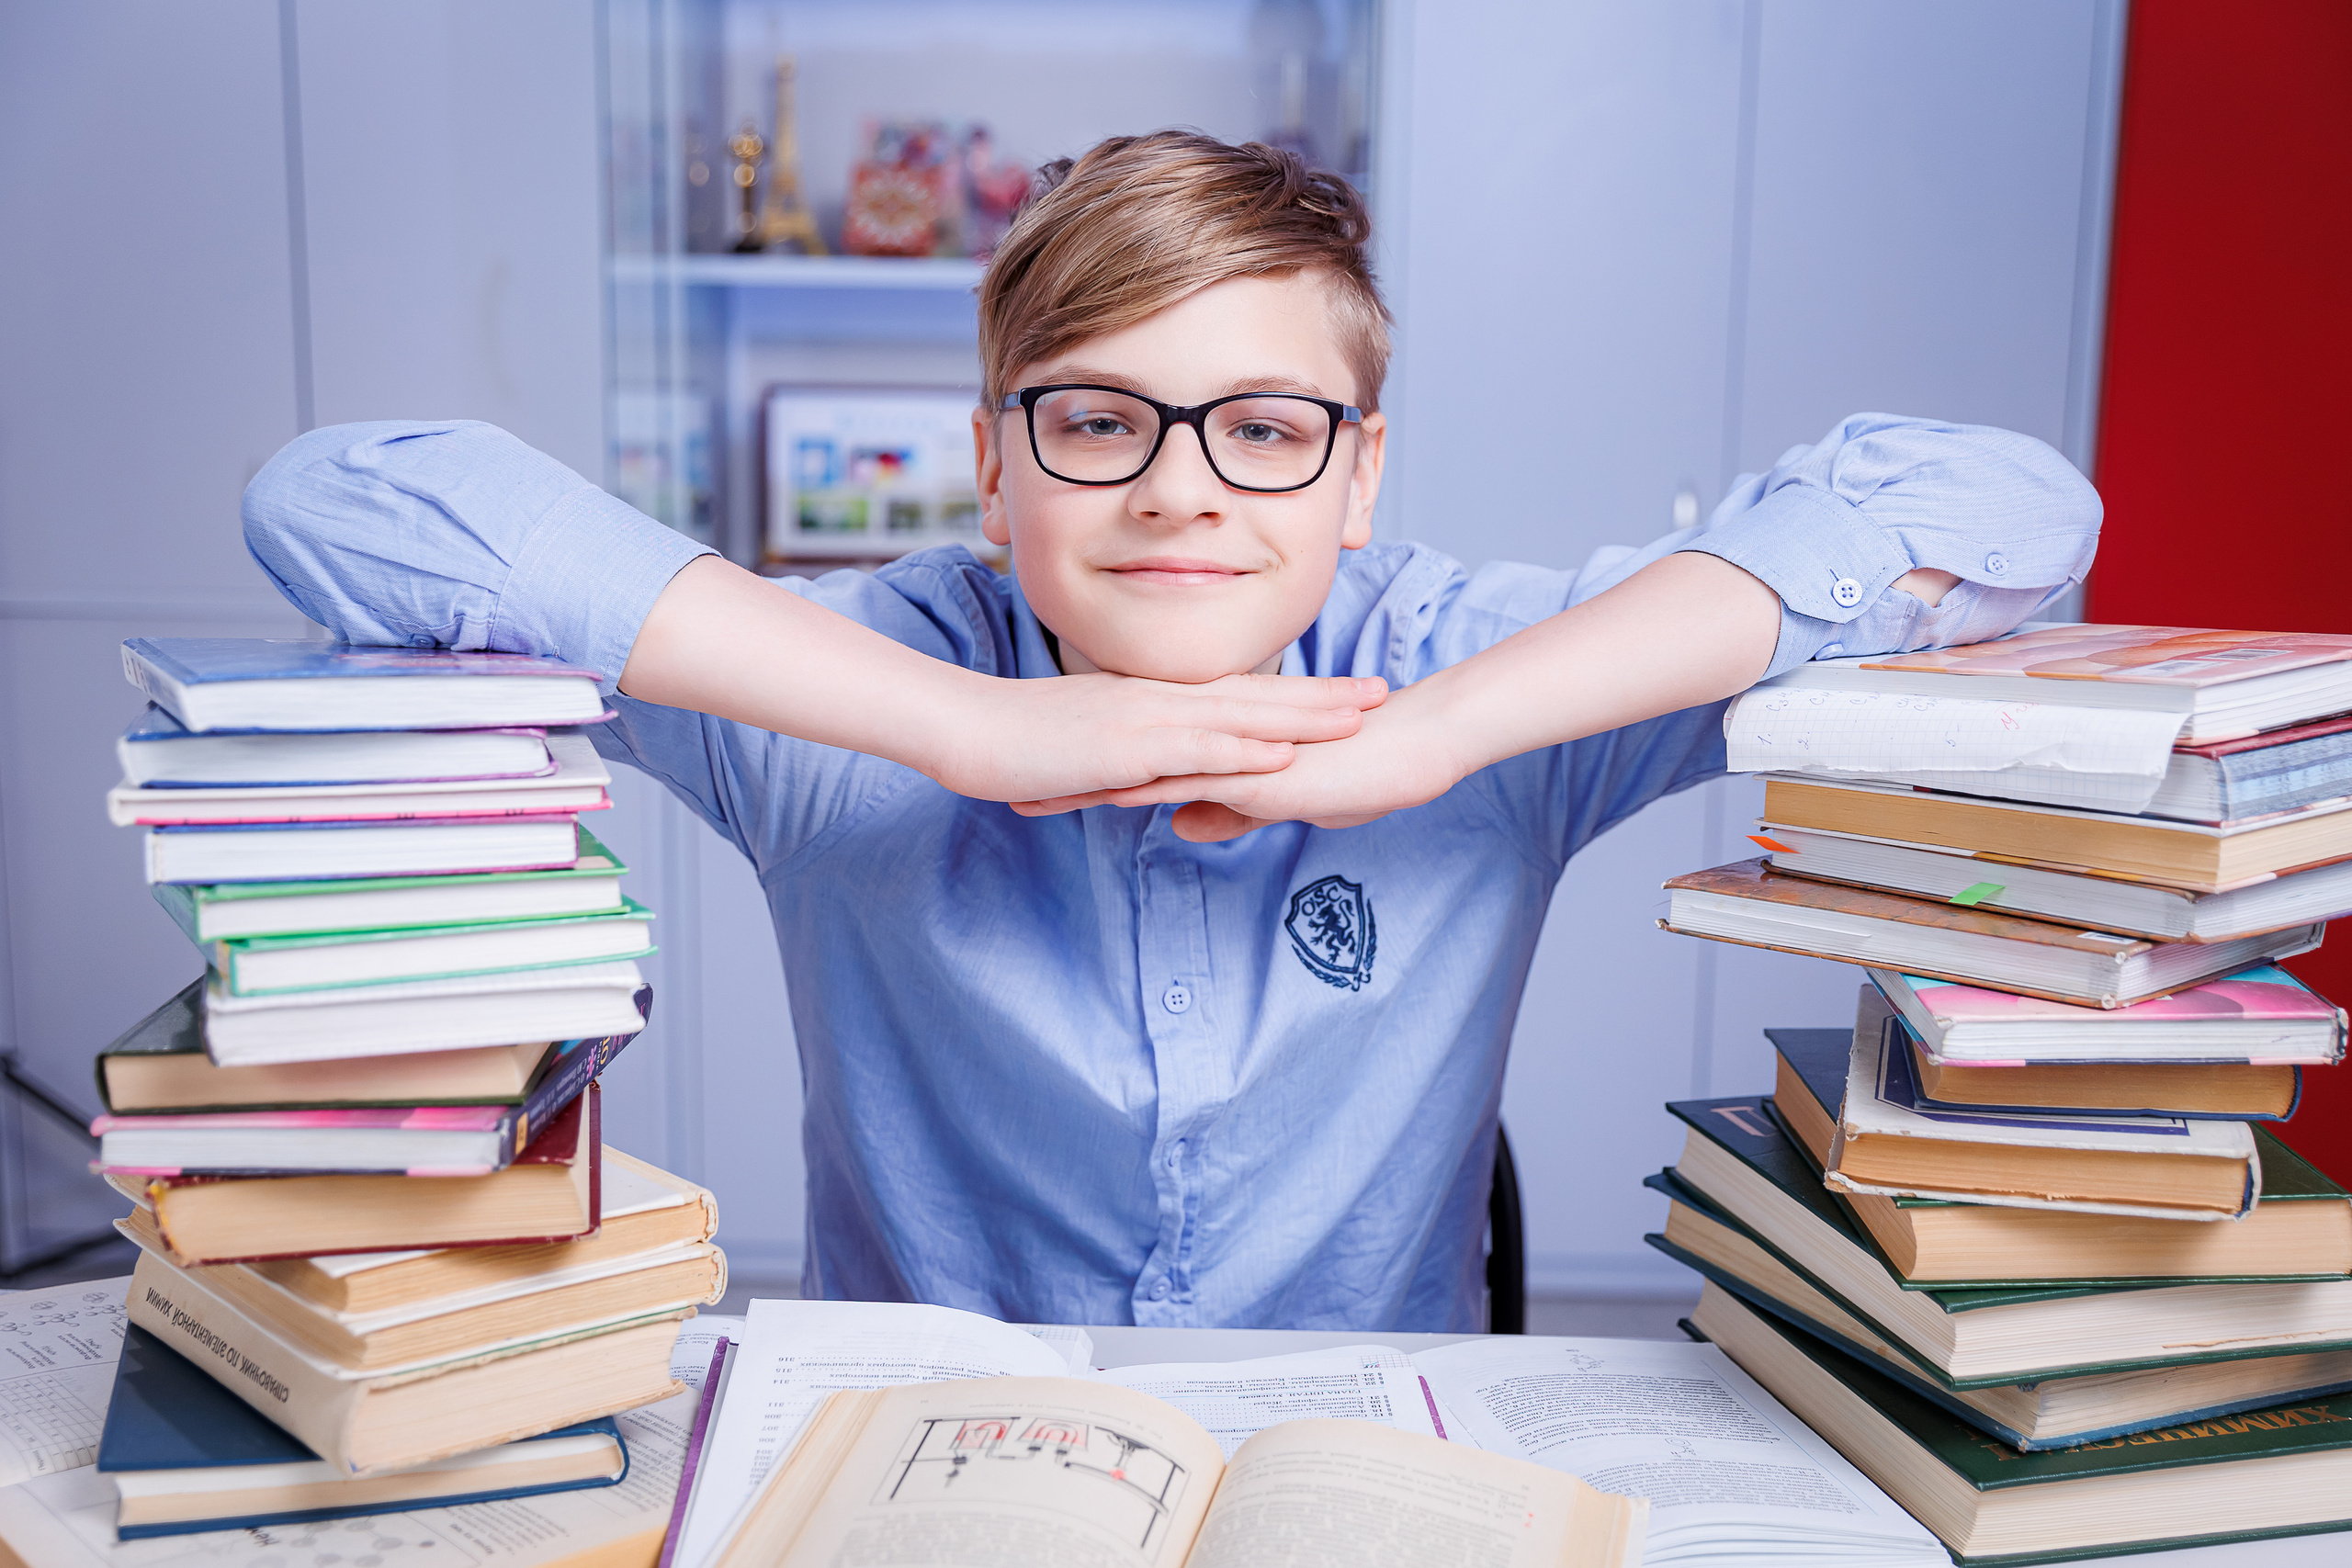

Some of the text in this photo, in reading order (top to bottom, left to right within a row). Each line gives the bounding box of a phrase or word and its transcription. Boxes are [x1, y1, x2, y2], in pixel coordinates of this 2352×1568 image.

[145, 1287, 174, 1317] ХИМИИ
[171, 1307, 227, 1358] ЭЛЕМЕНТАРНОЙ
[226, 1347, 240, 1368] ПО
[239, 1355, 289, 1404] СПРАВОЧНИК
